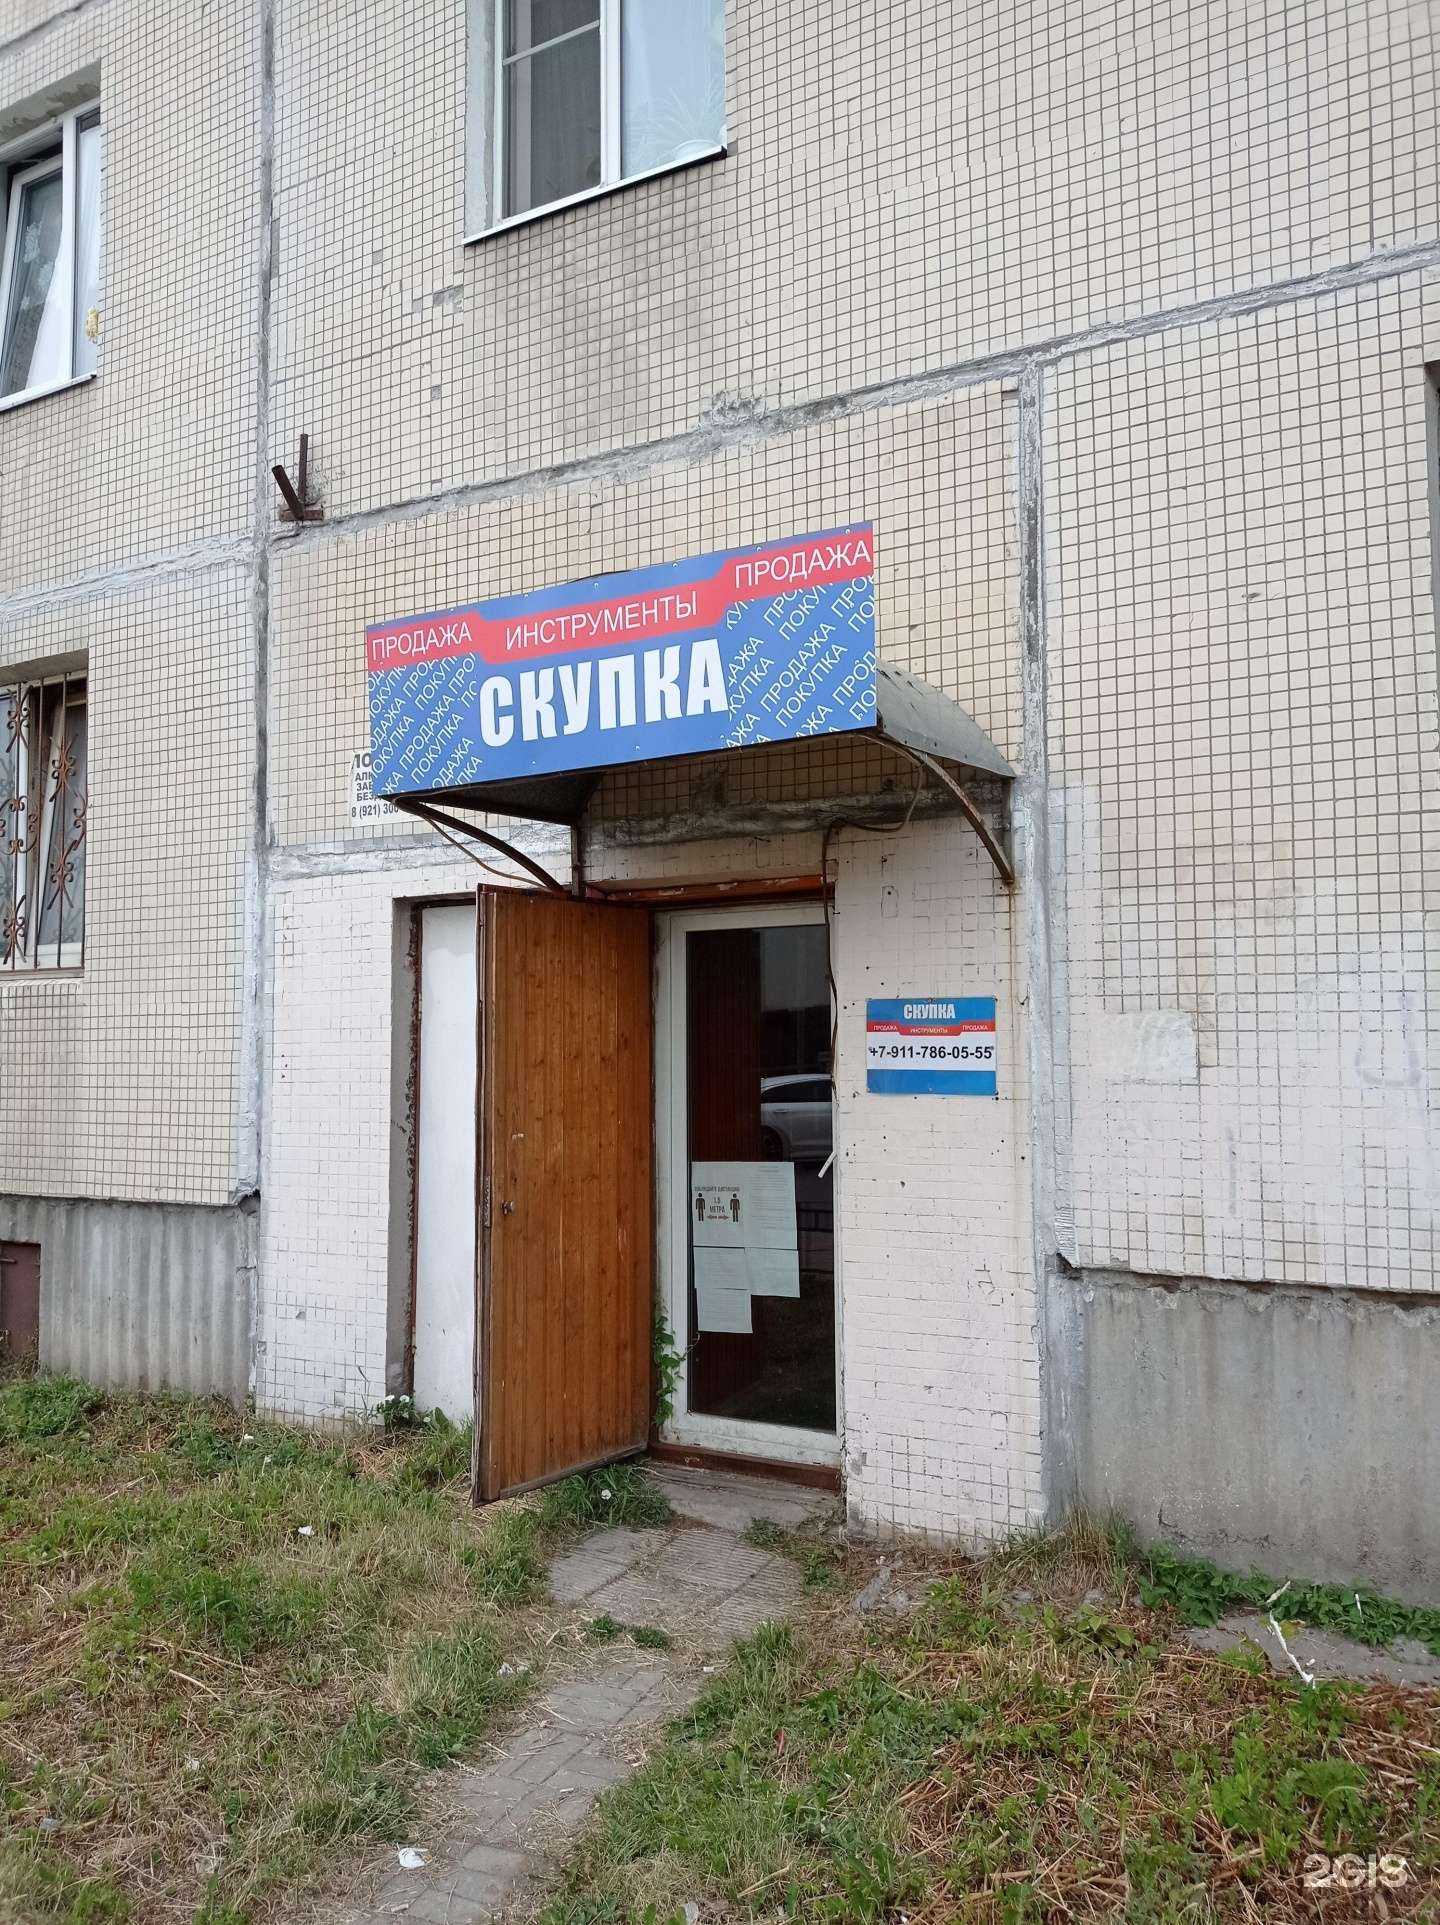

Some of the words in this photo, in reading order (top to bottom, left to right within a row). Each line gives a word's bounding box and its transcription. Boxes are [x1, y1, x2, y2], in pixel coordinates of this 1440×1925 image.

[735, 539, 871, 589] ПРОДАЖА
[371, 621, 473, 661] ПРОДАЖА
[505, 590, 698, 651] ИНСТРУМЕНТЫ
[479, 638, 729, 748] СКУПКА
[759, 622, 837, 713] ПРОДАЖА
[775, 643, 849, 728] ПОКУПКА
[399, 694, 456, 771] ПРОДАЖА
[411, 712, 465, 785] ПОКУПКА
[351, 807, 357, 818] 8
[359, 804, 381, 819] (921)
[873, 1024, 898, 1032] ПРОДАЖА
[962, 1024, 989, 1032] ПРОДАЖА
[903, 1003, 956, 1019] СКУПКА
[870, 1045, 993, 1060] +7-911-786-05-55
